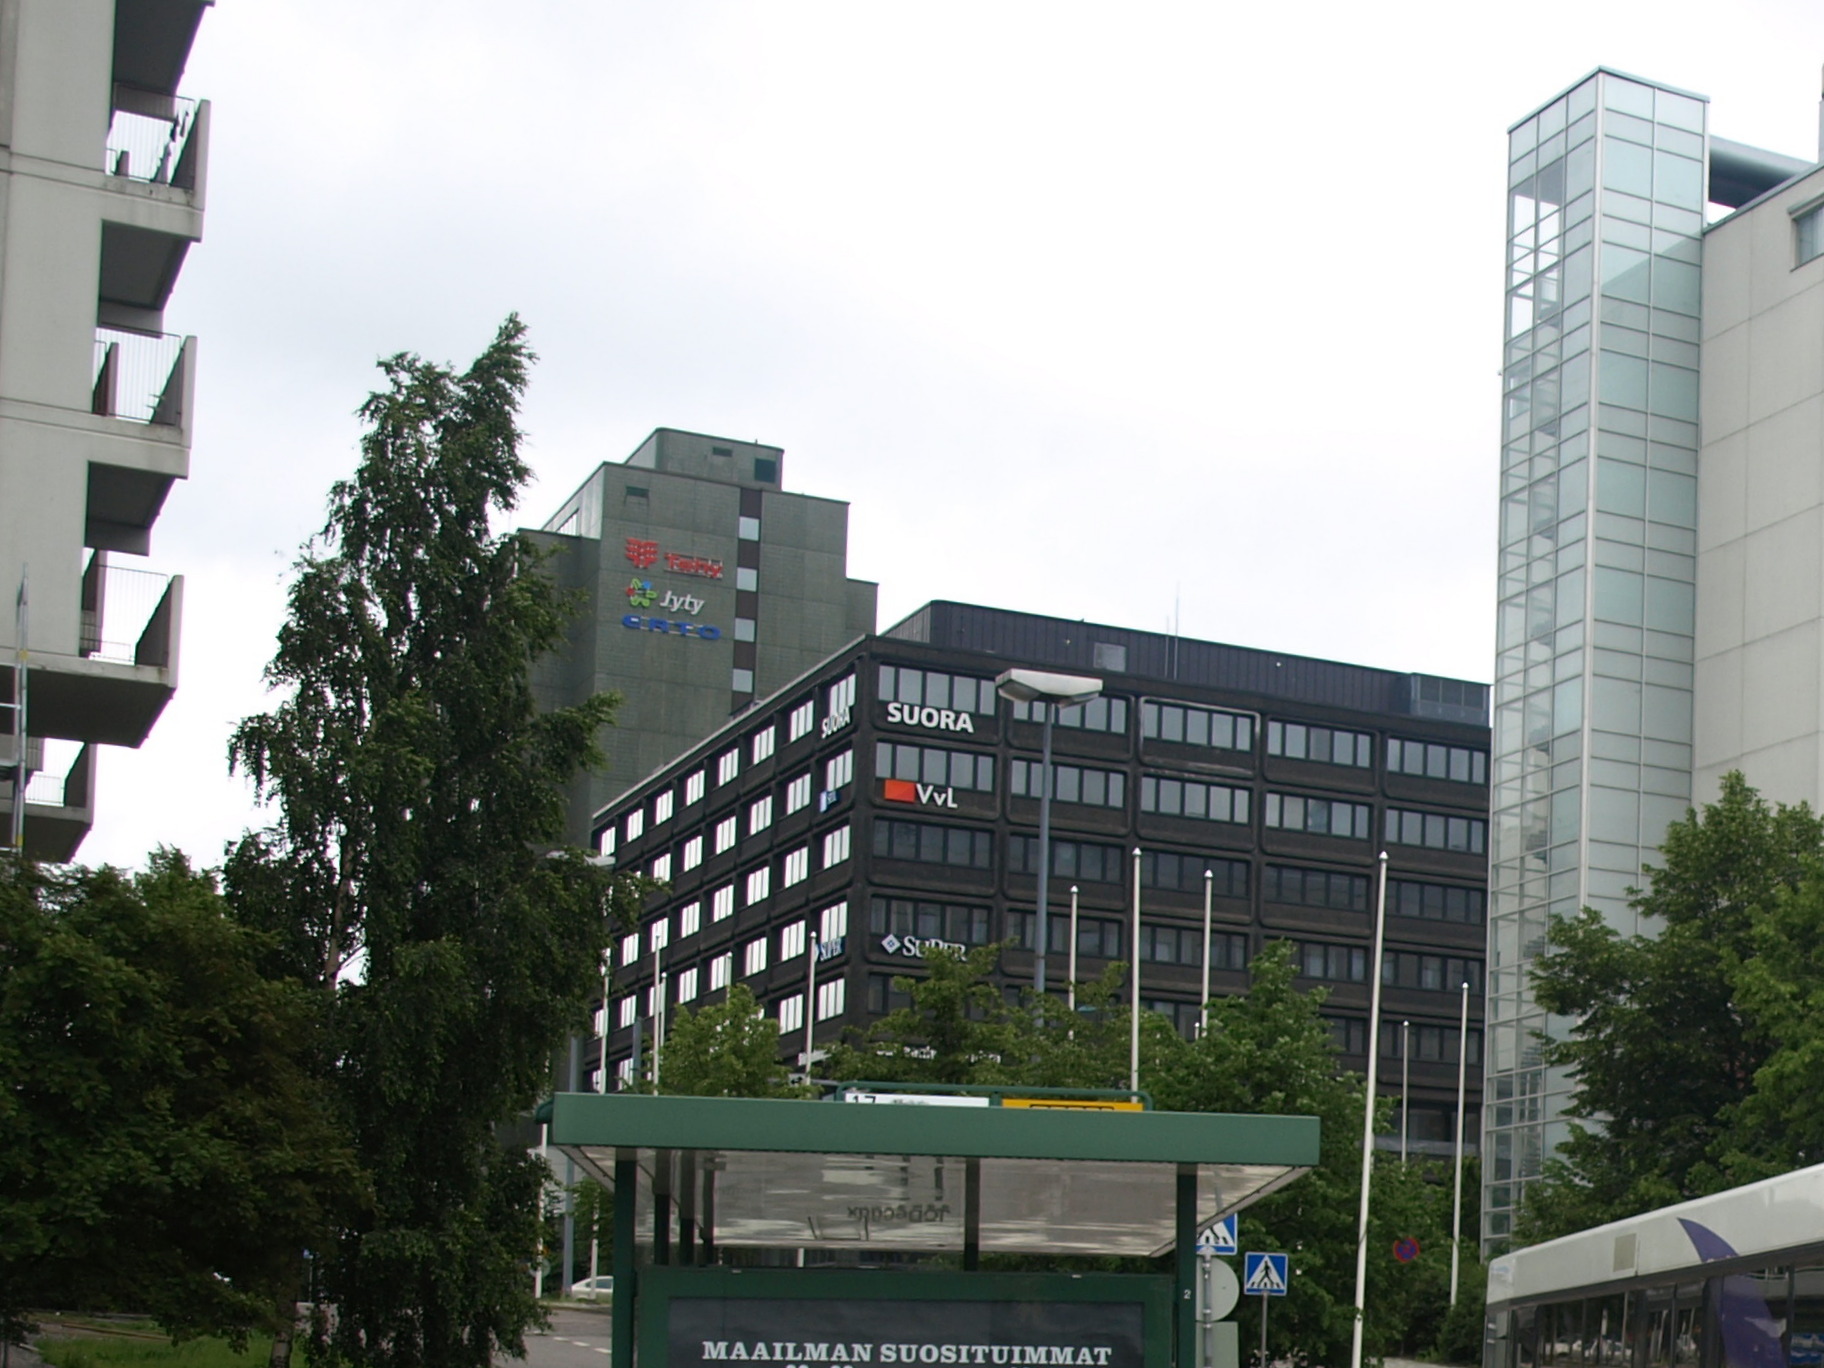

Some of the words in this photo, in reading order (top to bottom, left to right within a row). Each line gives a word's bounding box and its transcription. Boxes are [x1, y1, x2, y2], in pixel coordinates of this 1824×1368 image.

[660, 590, 705, 615] Jyty
[822, 705, 850, 739] SUORA
[888, 702, 974, 734] SUORA
[916, 783, 958, 809] VvL
[1184, 1289, 1191, 1299] 2
[702, 1341, 873, 1361] MAAILMAN
[880, 1344, 1112, 1366] SUOSITUIMMAT
